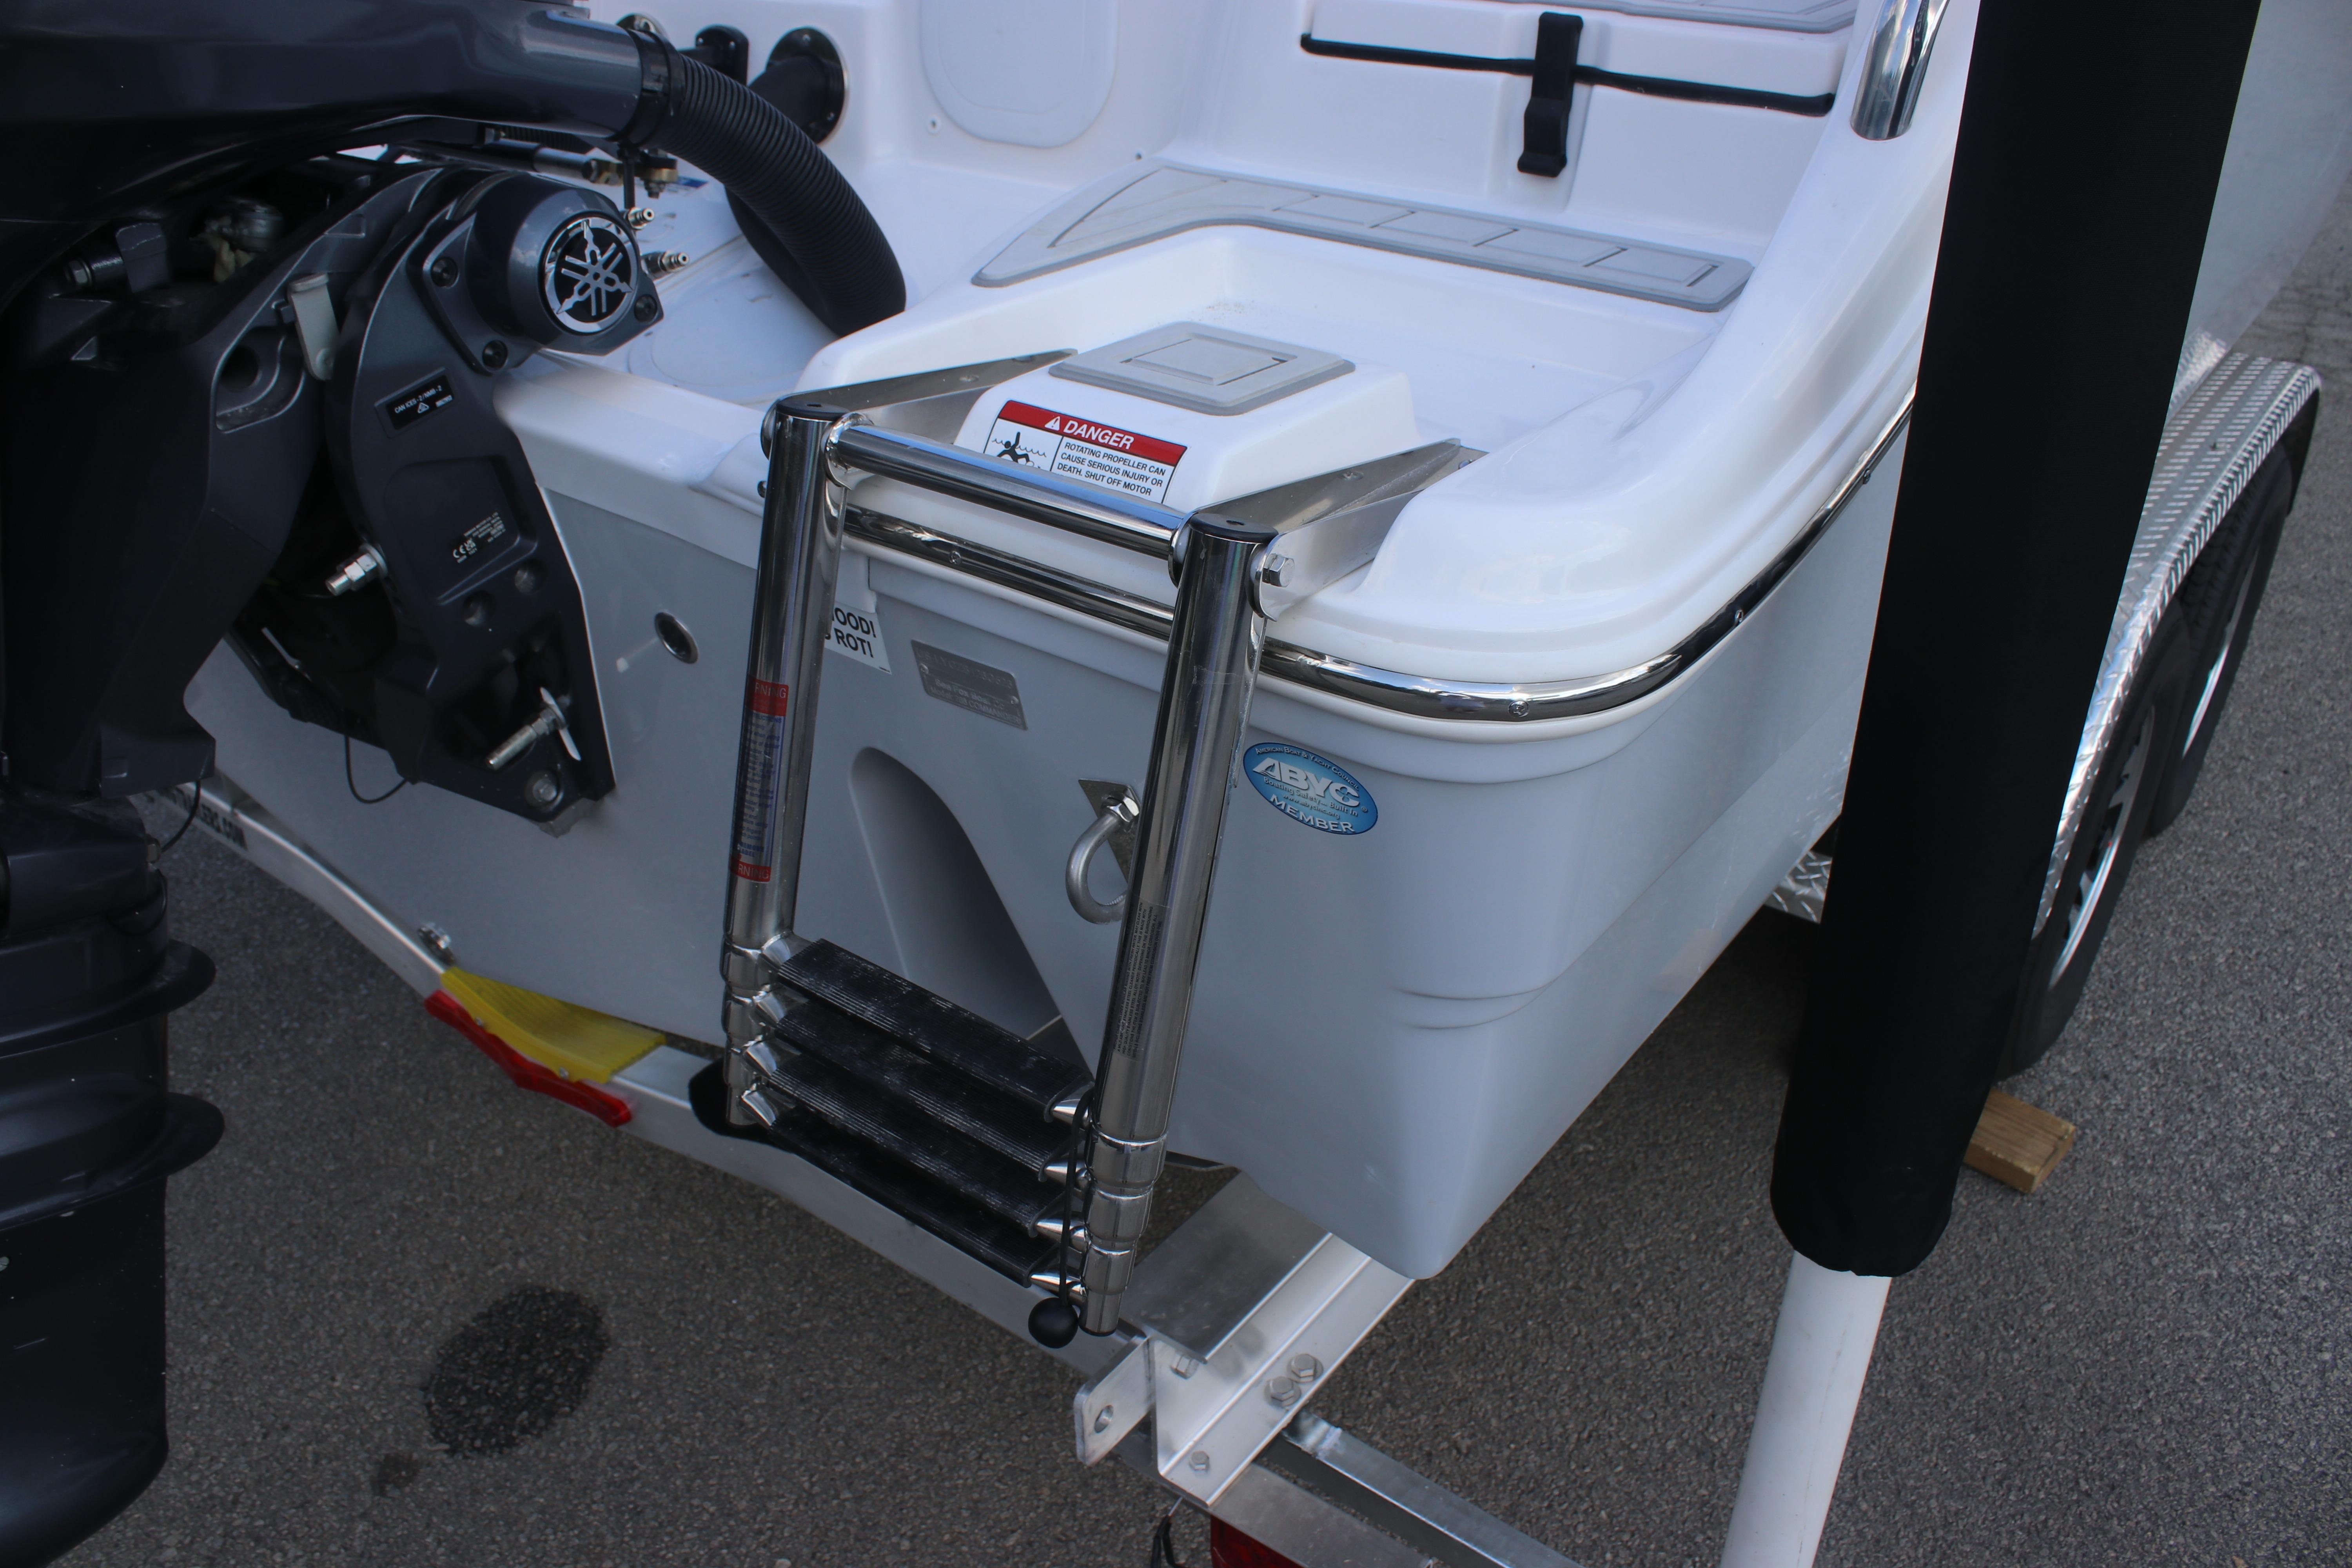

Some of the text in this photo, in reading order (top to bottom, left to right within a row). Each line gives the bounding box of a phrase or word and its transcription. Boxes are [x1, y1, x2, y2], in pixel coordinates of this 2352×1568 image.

[1063, 419, 1134, 450] DANGER
[1061, 452, 1163, 487] CAUSE SERIOUS INJURY OR
[1064, 442, 1166, 476] ROTATING PROPELLER CAN
[1057, 462, 1152, 496] DEATH. SHUT OFF MOTOR
[833, 607, 877, 638] OOD!
[835, 628, 874, 658] ROT!
[1252, 757, 1360, 808] ABYC
[1263, 777, 1294, 795] Boating
[1329, 801, 1348, 814] Built
[1270, 794, 1356, 833] MEMBER
[1282, 793, 1340, 820] www.abycinc.org
[737, 864, 769, 880] RNING
